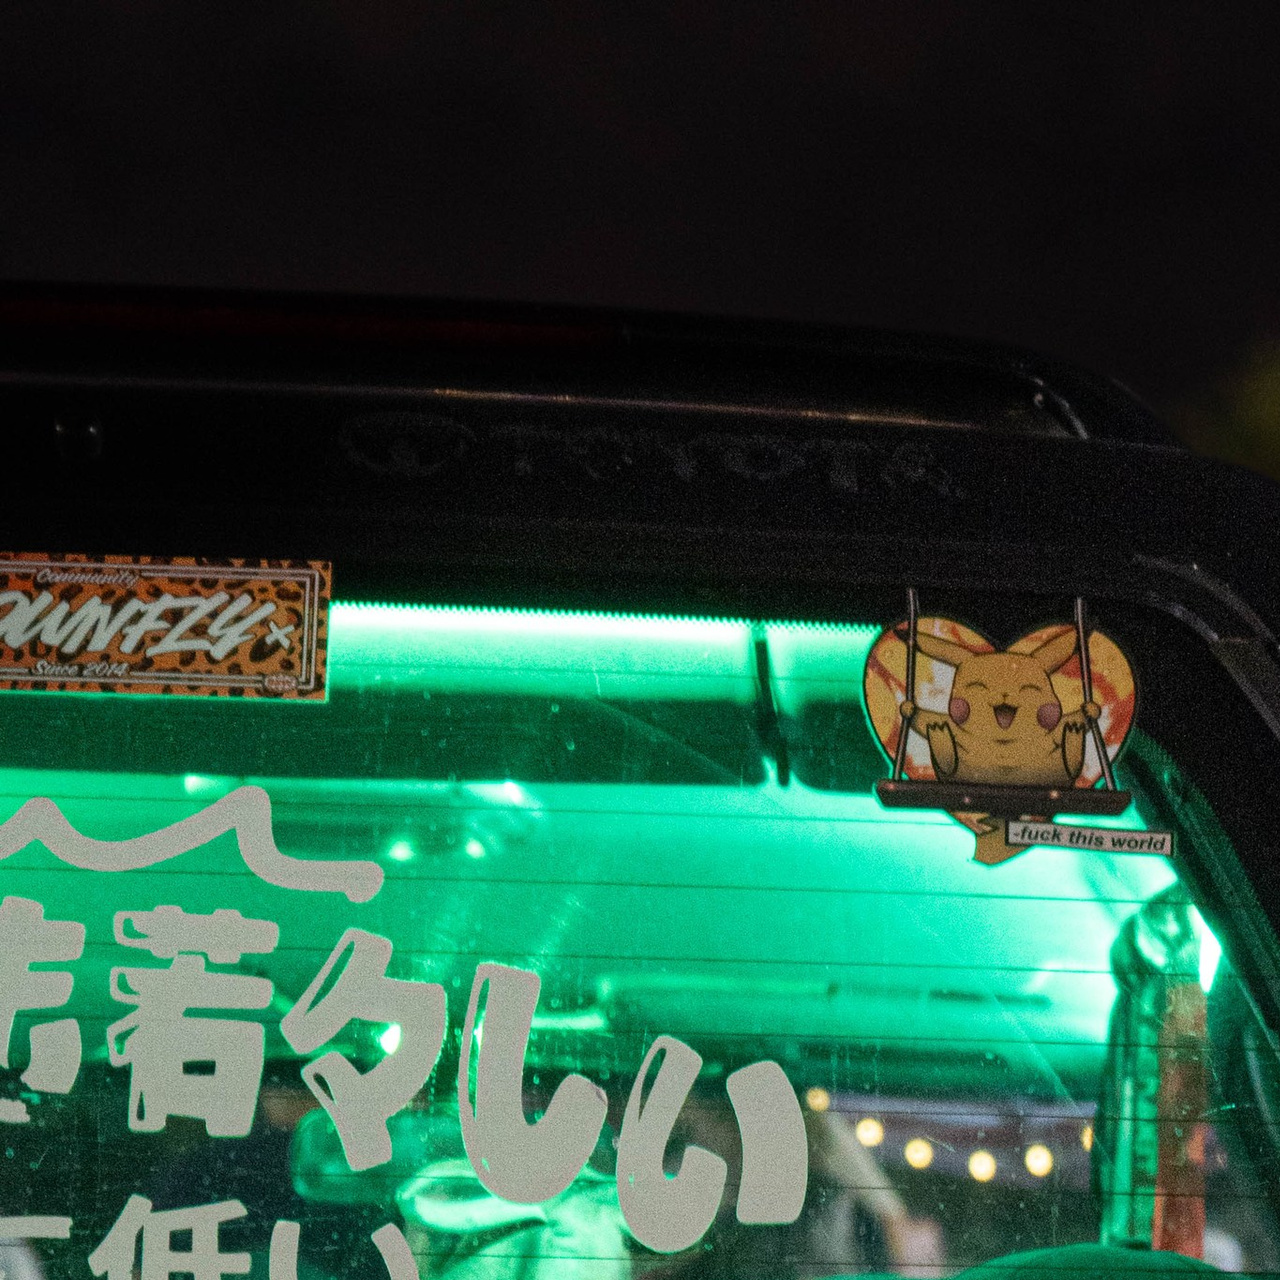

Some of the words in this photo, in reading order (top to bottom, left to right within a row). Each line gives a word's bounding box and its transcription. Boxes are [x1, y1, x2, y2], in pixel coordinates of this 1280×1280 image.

[37, 568, 139, 588] Community
[31, 659, 79, 675] Since
[82, 661, 129, 677] 2014
[1068, 831, 1104, 845] this
[1111, 835, 1165, 851] world
